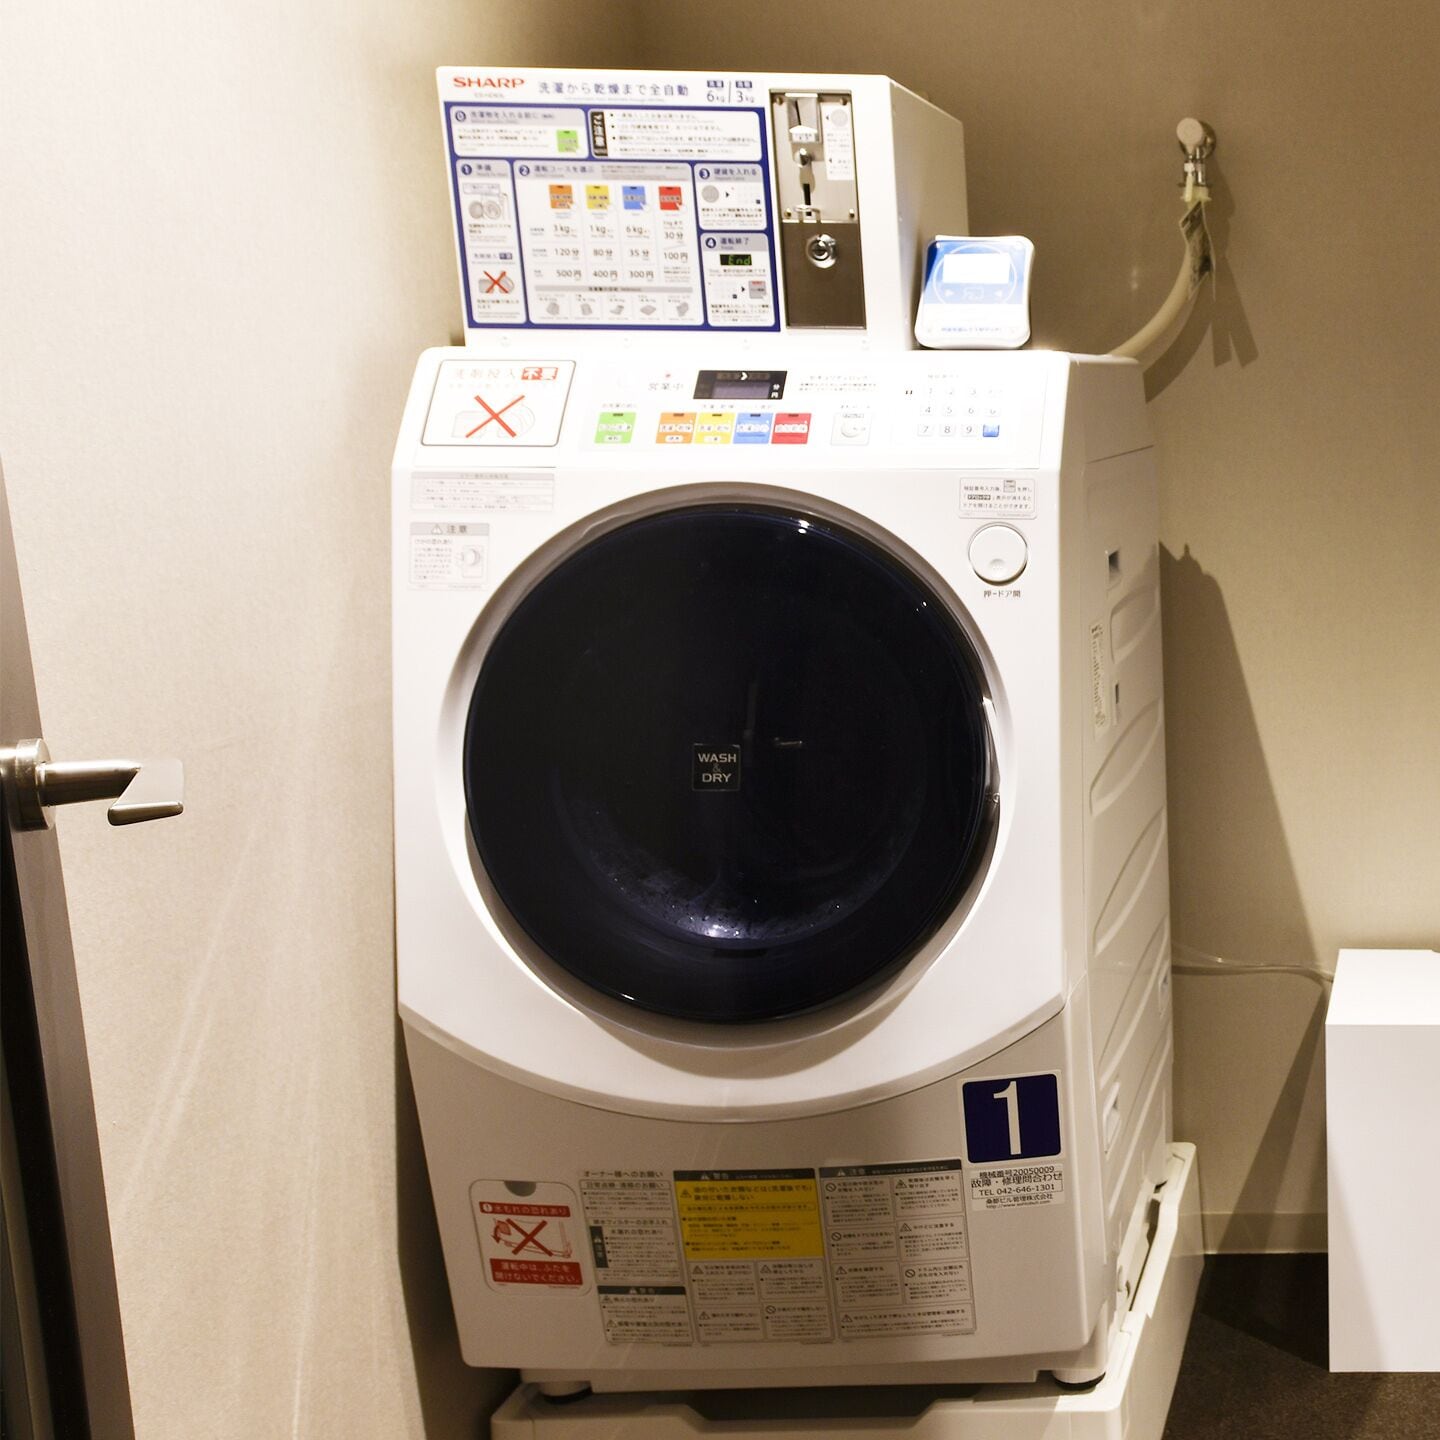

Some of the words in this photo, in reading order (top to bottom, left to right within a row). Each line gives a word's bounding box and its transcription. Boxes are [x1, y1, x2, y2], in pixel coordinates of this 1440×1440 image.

[453, 77, 525, 88] SHARP
[539, 82, 689, 97] 洗濯から乾燥まで全自動
[728, 255, 751, 265] End
[698, 753, 737, 763] WASH
[713, 763, 721, 773] &
[702, 773, 732, 783] DRY
[993, 1080, 1022, 1155] 1
[979, 1166, 1055, 1179] 機械番号20050009
[971, 1172, 1063, 1188] 故障・修理問合わせ
[979, 1189, 994, 1197] TEL
[996, 1183, 1055, 1195] 042-646-1301
[494, 1205, 568, 1216] 水もれの恐れあり
